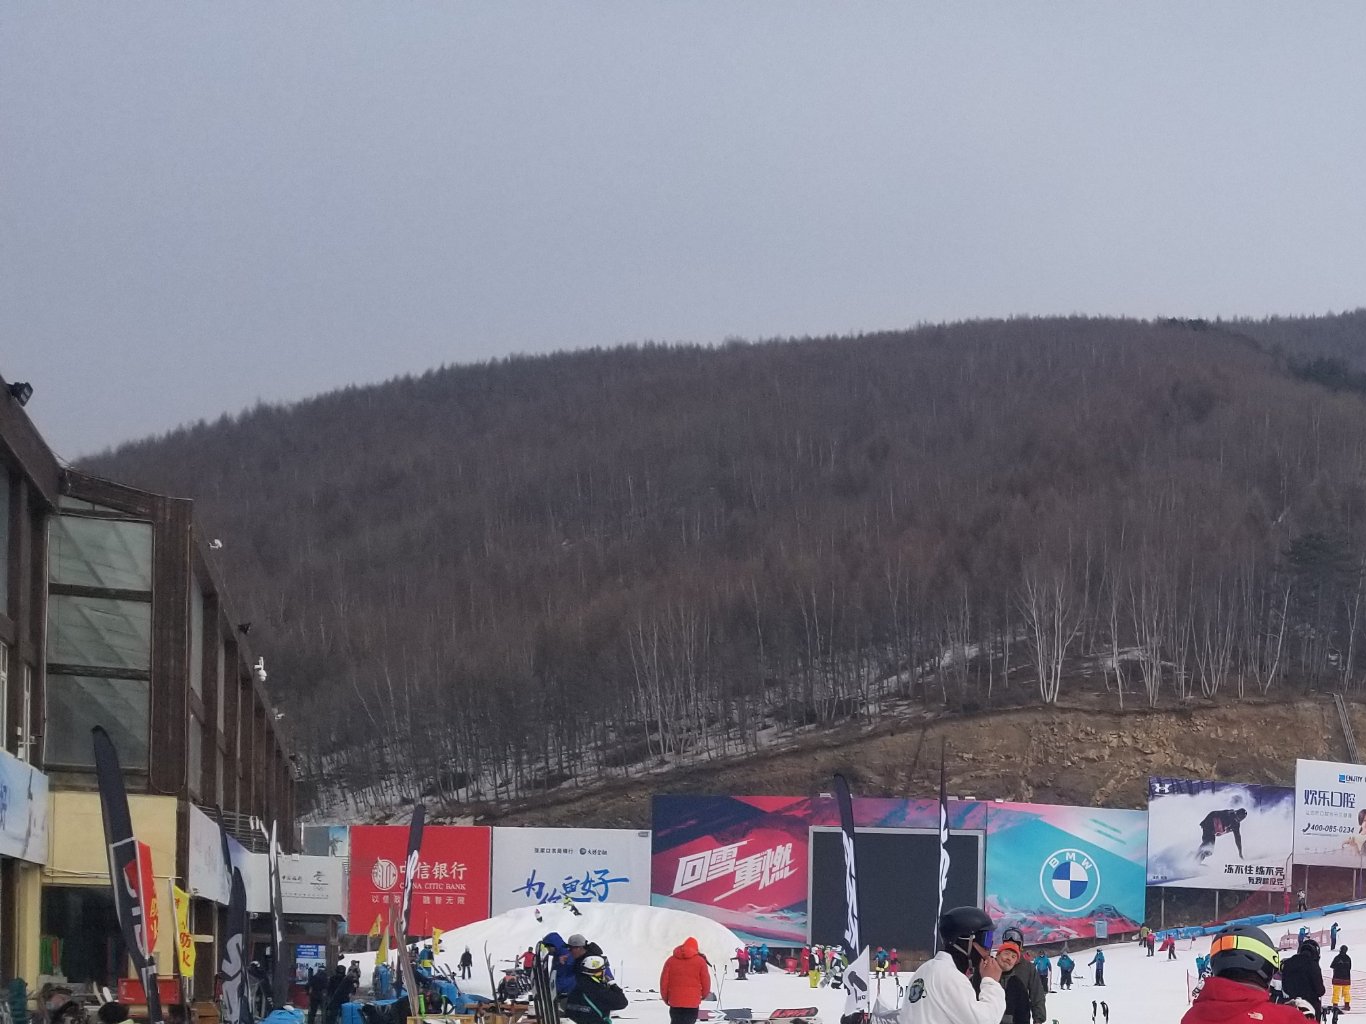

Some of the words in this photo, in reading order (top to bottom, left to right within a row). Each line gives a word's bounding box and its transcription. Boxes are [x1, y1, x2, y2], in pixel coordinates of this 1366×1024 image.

[1304, 789, 1356, 809] 欢乐口腔
[1310, 823, 1355, 834] 400-085-0234
[669, 839, 798, 902] 回雪重燃
[1048, 852, 1093, 870] BMW
